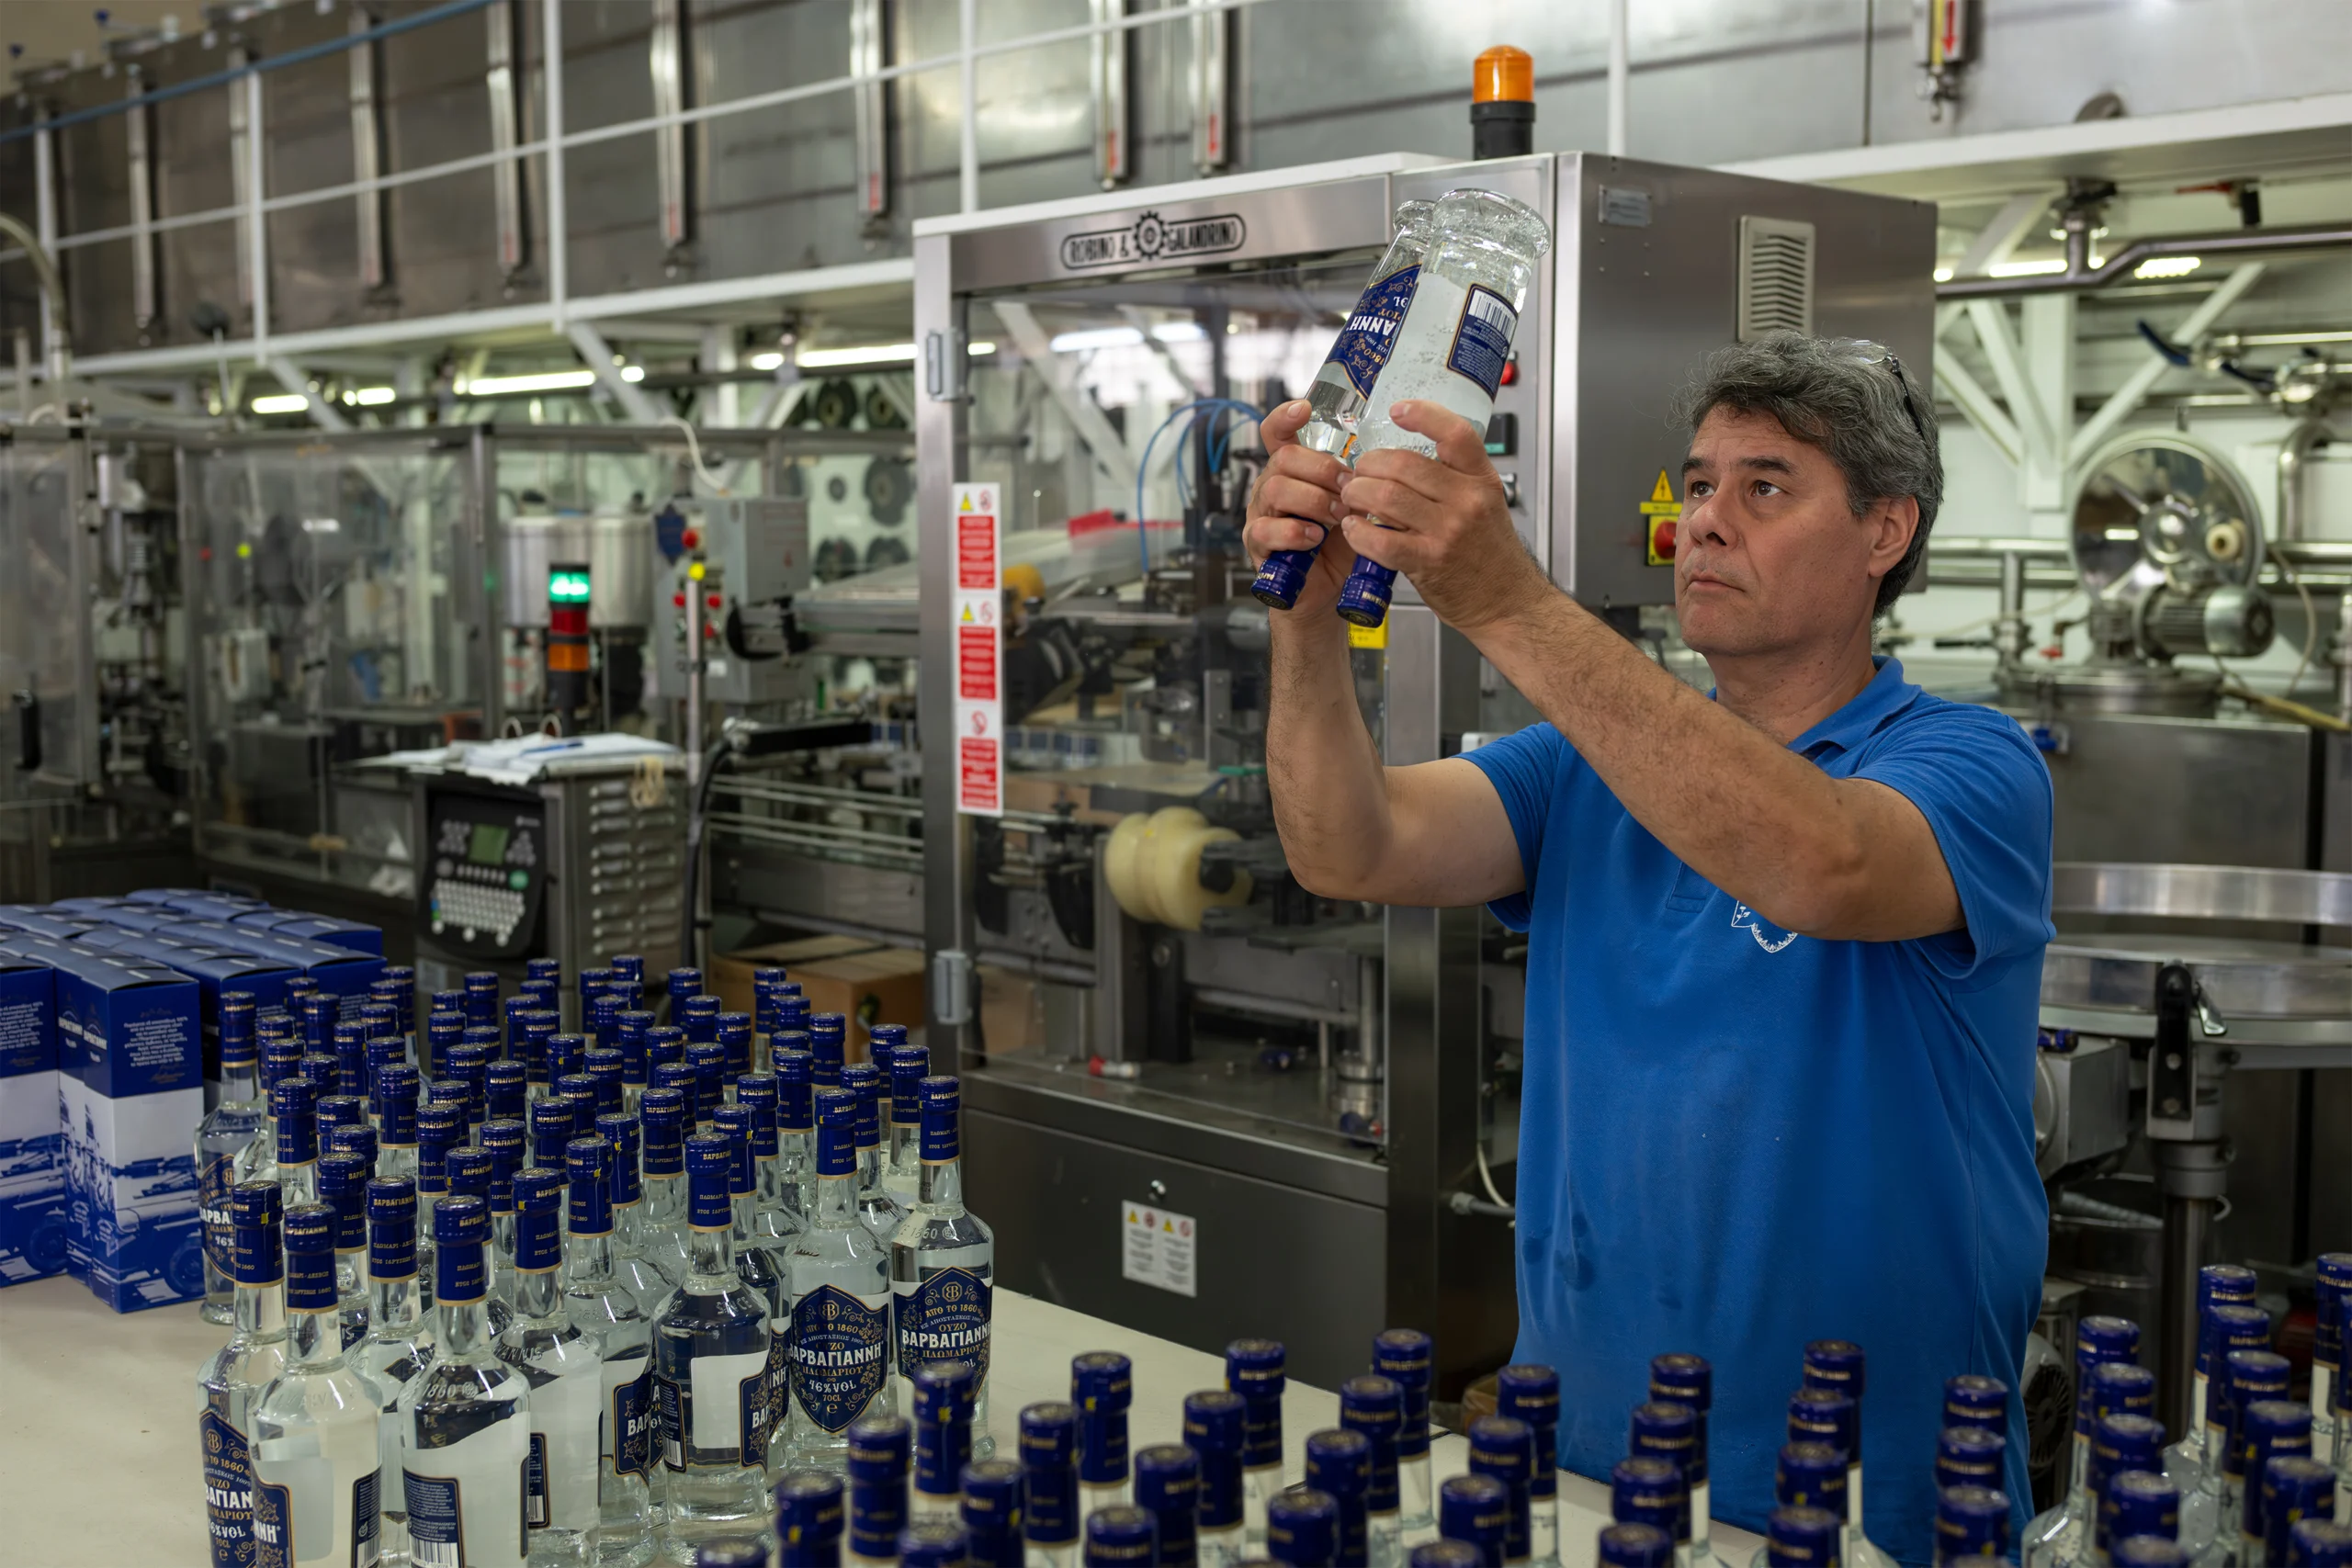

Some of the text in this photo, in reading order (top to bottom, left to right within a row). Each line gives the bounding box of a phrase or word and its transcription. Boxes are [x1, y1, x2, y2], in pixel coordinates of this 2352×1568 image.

[1070, 220, 1236, 263] ROBINO & GALANDRINO
[960, 1303, 978, 1314] 1860
[837, 1323, 859, 1334] 1860
[938, 1323, 967, 1333] ΟΥΖΟ
[922, 1344, 981, 1359] ΠΛΩΜΑΡΙΟΥ
[220, 1458, 244, 1473] 1860
